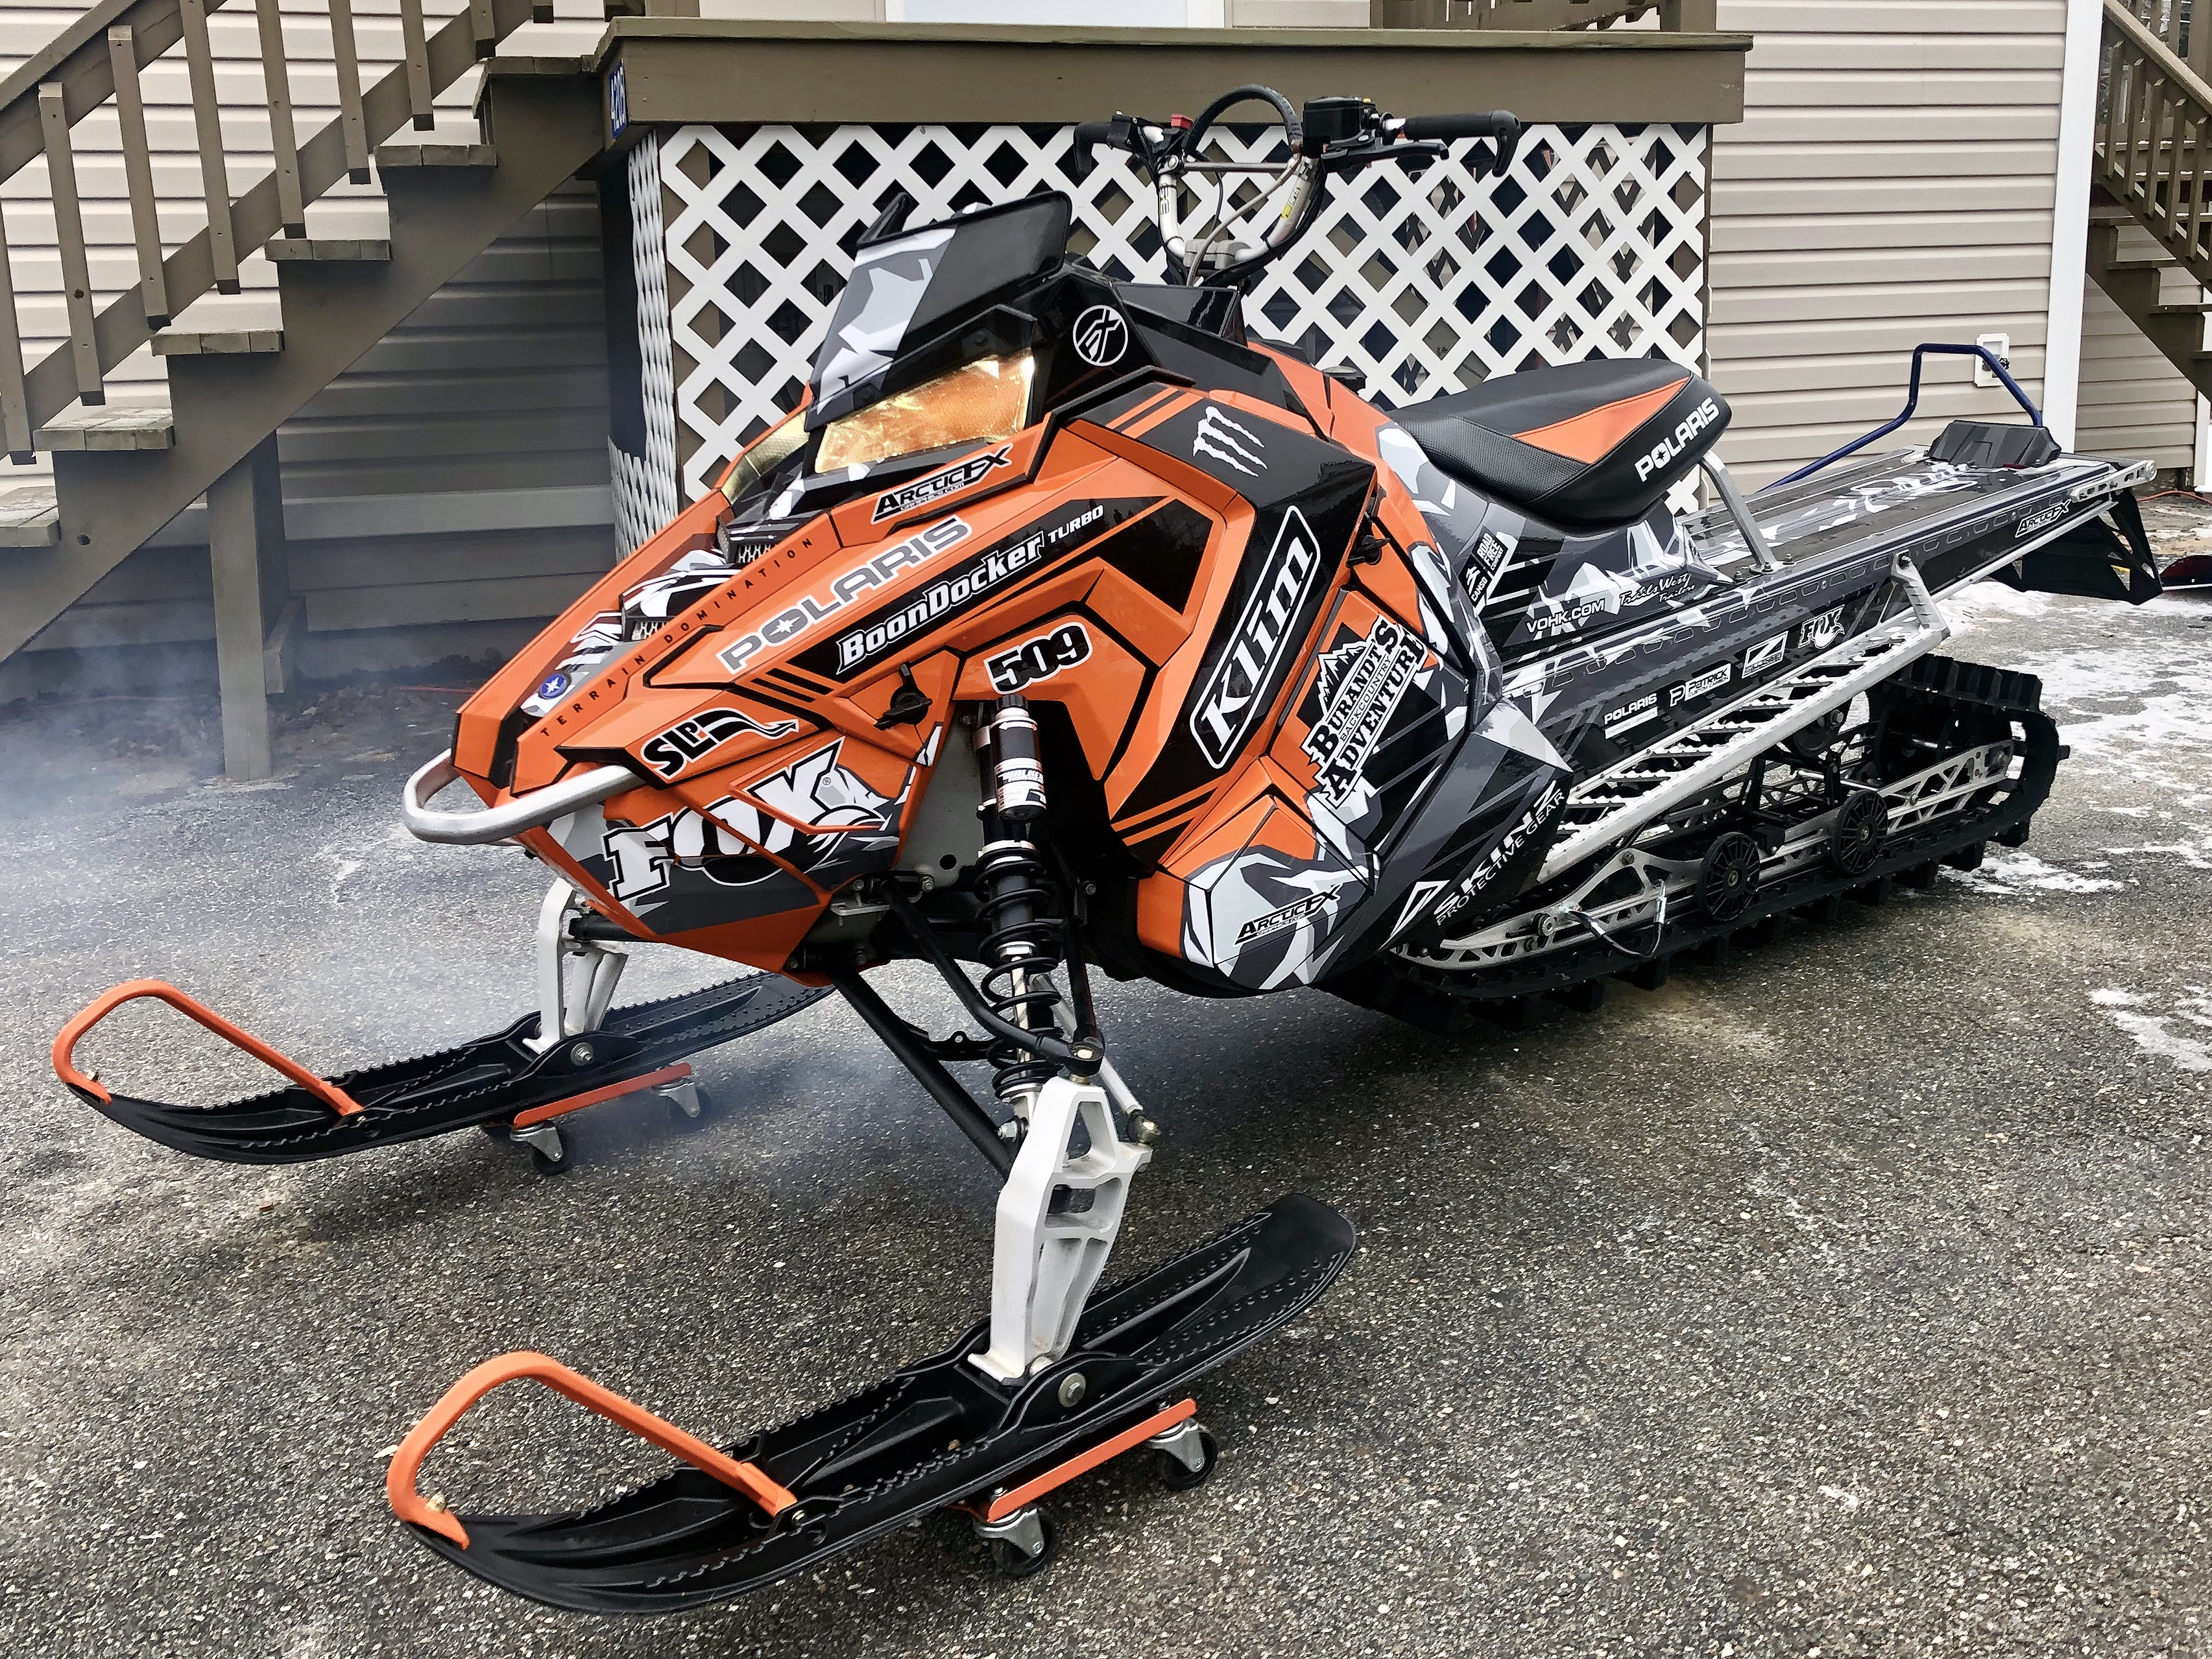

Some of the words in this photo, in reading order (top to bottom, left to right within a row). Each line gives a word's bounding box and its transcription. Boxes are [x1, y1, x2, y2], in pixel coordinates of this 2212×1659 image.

[1634, 396, 1720, 483] POLARIS
[1047, 504, 1105, 544] TURBO
[1476, 532, 1493, 559] ROAD
[1484, 539, 1501, 567] FREE
[1490, 547, 1504, 571] COMPANY
[719, 517, 970, 673] POLARIS
[1471, 576, 1488, 602] CAMSO
[1659, 584, 1696, 603] Trailers
[540, 654, 645, 737] TERRAIN
[664, 536, 813, 644] DOMINATION
[1526, 600, 1605, 634] VOHK.COM
[1799, 604, 1845, 649] FOX
[987, 625, 1090, 693] 509
[1339, 657, 1391, 743] BACKCOUNTRY
[1604, 693, 1658, 725] POLARIS
[641, 719, 717, 779] SLP
[601, 737, 846, 903] FOX
[1436, 839, 1526, 926] PROTECTIVE
[1526, 792, 1566, 835] GEAR
